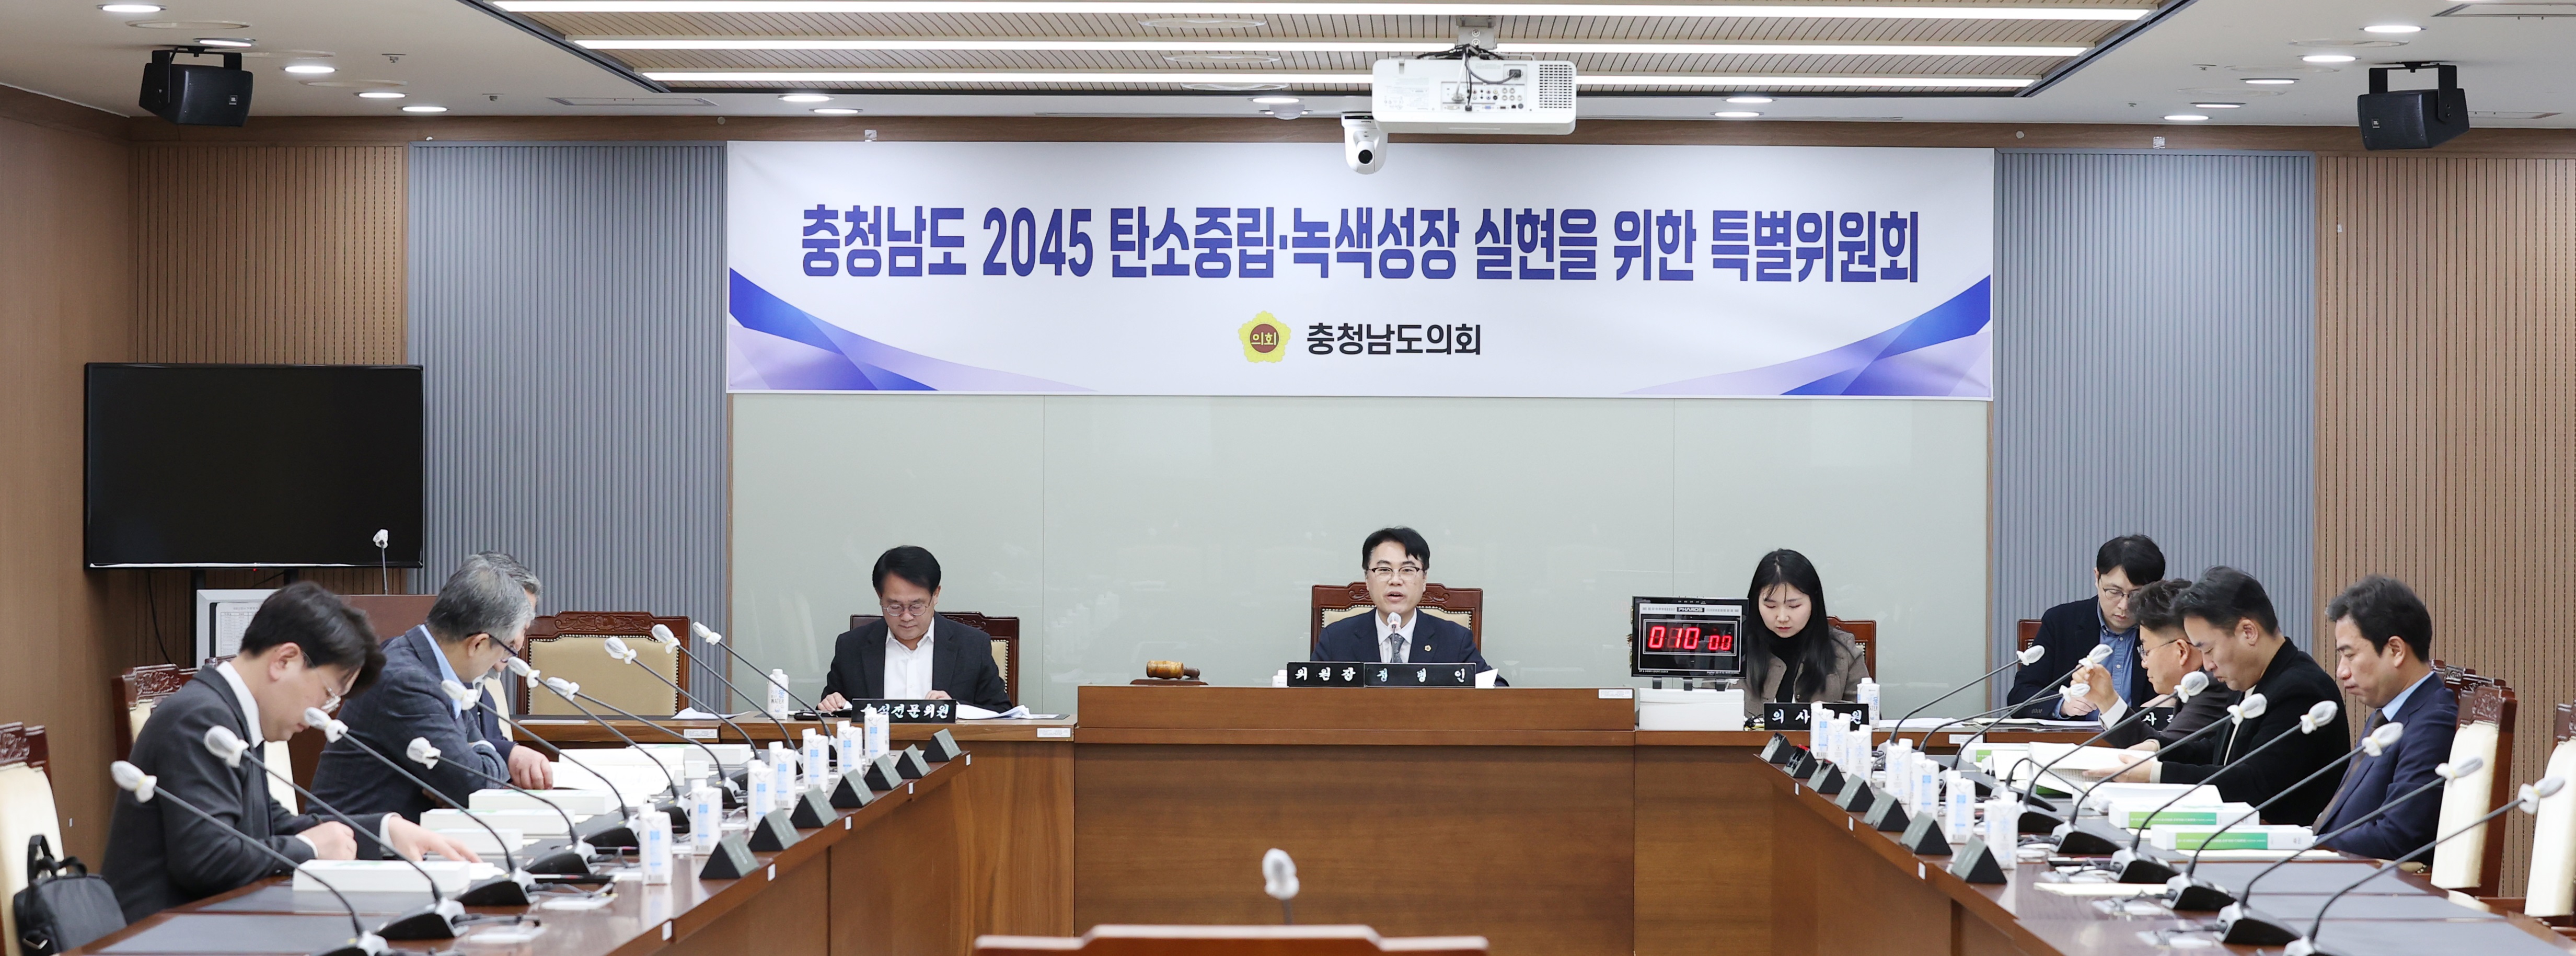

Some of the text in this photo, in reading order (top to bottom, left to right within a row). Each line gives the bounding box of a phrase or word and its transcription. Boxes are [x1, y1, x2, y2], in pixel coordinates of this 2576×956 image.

[802, 204, 1920, 283] 충청남도 2045 탄소중립·녹색성장 실현을 위한 특별위원회
[1251, 331, 1277, 346] 의회
[1307, 322, 1481, 355] 충청남도의회
[1295, 667, 1356, 682] 위원장
[1377, 668, 1465, 683] 정병인
[1772, 709, 1863, 724] 의사원
